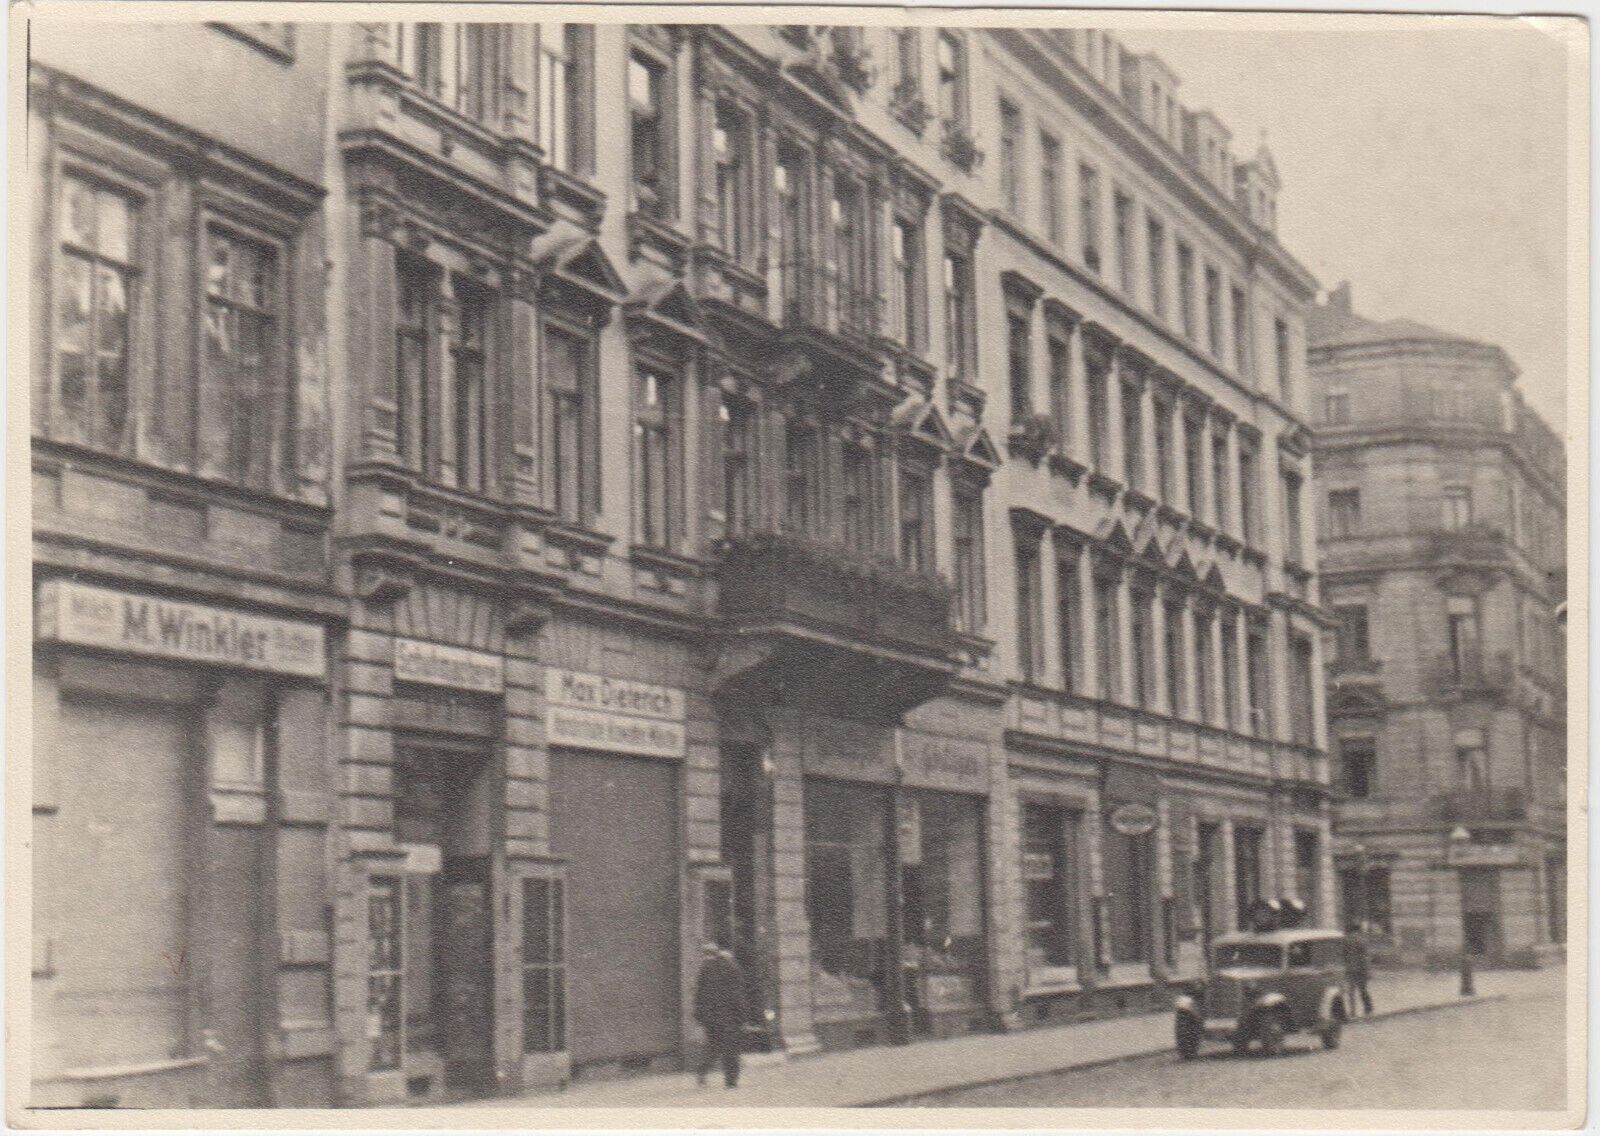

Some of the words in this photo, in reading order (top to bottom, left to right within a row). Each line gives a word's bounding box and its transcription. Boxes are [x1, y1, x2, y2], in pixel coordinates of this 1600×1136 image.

[155, 604, 267, 660] Winkler
[561, 673, 595, 703] Max
[601, 678, 673, 714] Dieterich
